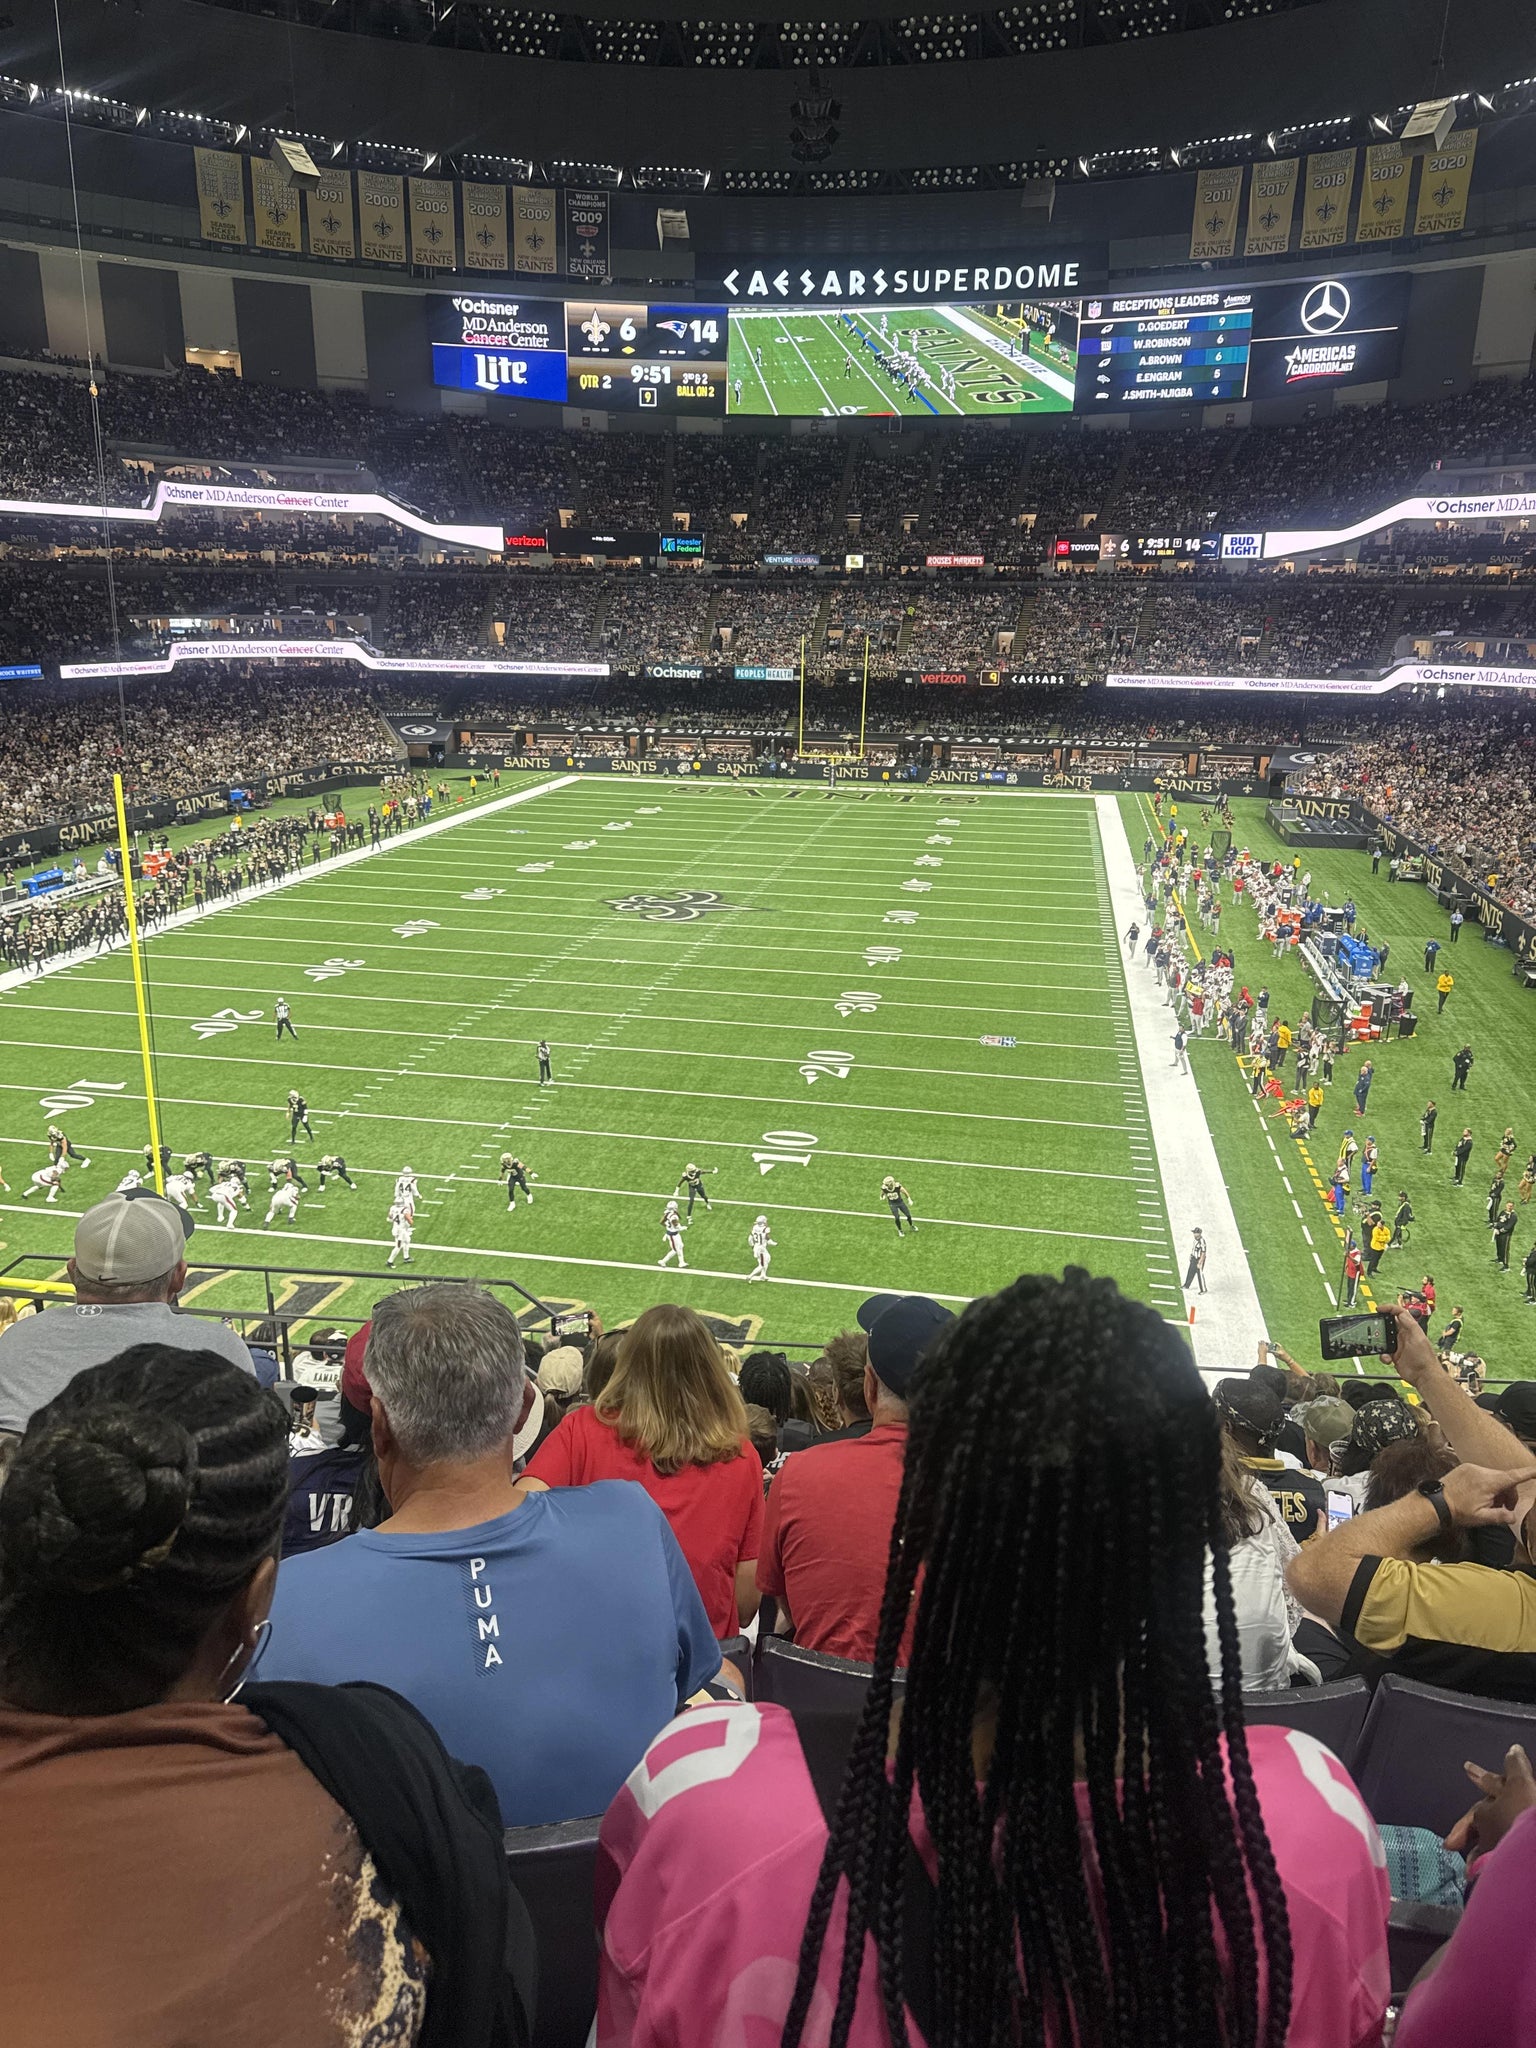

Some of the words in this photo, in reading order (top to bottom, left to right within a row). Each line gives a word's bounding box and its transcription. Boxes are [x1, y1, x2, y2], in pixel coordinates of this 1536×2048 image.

[1429, 155, 1466, 171] 2020
[1371, 165, 1403, 181] 2019
[1313, 173, 1346, 189] 2018
[316, 188, 343, 203] 1991
[1203, 188, 1232, 204] 2011
[1258, 182, 1289, 198] 2017
[365, 193, 398, 208] 2000
[416, 200, 448, 213] 2006
[568, 200, 606, 208] CHAMPIONS
[469, 204, 500, 217] 2009
[519, 207, 550, 220] 2009
[572, 211, 603, 224] 2009
[1418, 217, 1461, 232] SAINTS
[1303, 232, 1343, 246] SAINTS
[1359, 225, 1400, 240] SAINTS
[313, 243, 352, 257] SAINTS
[364, 247, 403, 261] SAINTS
[1193, 245, 1231, 257] SAINTS
[1247, 241, 1286, 254] SAINTS
[416, 254, 453, 265] SAINTS
[468, 257, 505, 269] SAINTS
[517, 260, 554, 272] SAINTS
[570, 264, 606, 274] SAINTS
[723, 268, 897, 296] CAESARS
[894, 263, 1080, 292] SUPERDOME
[461, 299, 519, 316] Ochsner
[1112, 299, 1173, 312] RECEPTIONS
[1174, 294, 1219, 307] LEADERS
[462, 317, 486, 331] MD
[487, 318, 548, 334] Anderson
[619, 318, 636, 341] 6
[1138, 320, 1189, 332] D.GOEDERT
[1219, 317, 1226, 327] 9
[689, 320, 719, 343] 14
[462, 330, 507, 346] Cancer
[508, 333, 549, 348] Center
[1133, 337, 1191, 349] W.ROBINSON
[1217, 335, 1224, 344] 6
[1139, 355, 1182, 366] A.BROWN
[1215, 352, 1222, 361] 6
[1288, 345, 1356, 366] AMERICAS
[474, 353, 527, 391] Lite
[630, 364, 671, 383] 9:51
[1292, 361, 1354, 375] CARDROOM.NET
[579, 374, 599, 389] QTR
[602, 375, 612, 389] 2
[702, 374, 708, 385] 2
[1136, 371, 1182, 383] E.ENGRAM
[1214, 369, 1221, 379] 5
[644, 391, 651, 402] 9
[676, 385, 696, 397] BALL
[697, 386, 708, 397] ON
[708, 386, 715, 397] 2
[1122, 388, 1193, 400] J.SMITH-NJIGBA
[1211, 386, 1219, 396] 4
[166, 485, 203, 501] Ochsner
[205, 488, 225, 501] MD
[225, 490, 276, 505] Anderson
[277, 494, 313, 507] Cancer
[314, 495, 349, 508] Center
[1436, 499, 1495, 514] Ochsner
[1496, 498, 1519, 511] MD
[11, 534, 39, 543] SAINTS
[71, 536, 98, 545] SAINTS
[134, 539, 164, 548] SAINTS
[505, 535, 545, 547] verizon
[676, 537, 702, 547] Keesler
[1120, 539, 1129, 551] 6
[1146, 538, 1169, 548] 9:51
[1185, 538, 1201, 551] 14
[1230, 536, 1254, 546] BUD
[198, 541, 227, 550] SAINTS
[263, 543, 293, 552] SAINTS
[327, 545, 356, 554] SAINTS
[676, 545, 701, 553] Federal
[1070, 543, 1099, 551] TOYOTA
[1225, 545, 1259, 556] LIGHT
[728, 555, 756, 563] SAINTS
[927, 556, 952, 565] ROUSES
[953, 556, 983, 565] MARKETS
[1416, 556, 1449, 564] SAINTS
[1489, 555, 1523, 564] SAINTS
[212, 645, 230, 655] MD
[230, 644, 278, 655] Anderson
[279, 643, 313, 654] Cancer
[314, 644, 344, 655] Center
[74, 667, 99, 675] Ochsner
[613, 664, 640, 672] SAINTS
[653, 666, 702, 679] Ochsner
[736, 668, 765, 678] PEOPLES
[767, 669, 793, 679] HEALTH
[807, 669, 835, 678] SAINTS
[870, 670, 898, 679] SAINTS
[920, 673, 966, 684] verizon
[989, 673, 997, 683] 9
[1011, 675, 1065, 685] CAESARS
[1074, 673, 1105, 682] SAINTS
[1117, 676, 1146, 685] Ochsner
[1423, 669, 1476, 681] Ochsner
[1477, 671, 1497, 681] MD
[1497, 672, 1536, 685] Anders
[1249, 680, 1280, 688] Ochsner
[565, 725, 670, 734] CAESARS
[672, 728, 795, 738] SUPERDOME
[905, 735, 1014, 744] CAESARS
[1018, 737, 1151, 749] SUPERDOME
[503, 757, 550, 769] SAINTS
[611, 759, 657, 772] SAINTS
[823, 766, 869, 779] SAINTS
[930, 769, 978, 783] SAINTS
[1159, 778, 1212, 792] SAINTS
[1281, 798, 1350, 820] SAINTS
[59, 814, 118, 842] SAINTS
[882, 910, 920, 925] 50
[862, 946, 903, 964] 40
[304, 958, 365, 977] 30
[834, 991, 882, 1013] 30
[190, 1008, 264, 1032] 20
[799, 1050, 855, 1080] 20
[39, 1079, 127, 1110] 10
[752, 1130, 818, 1167] 10
[399, 1183, 412, 1193] 44
[753, 1232, 763, 1245] 31
[313, 1372, 340, 1383] KAMAR
[470, 1557, 503, 1668] PUMA
